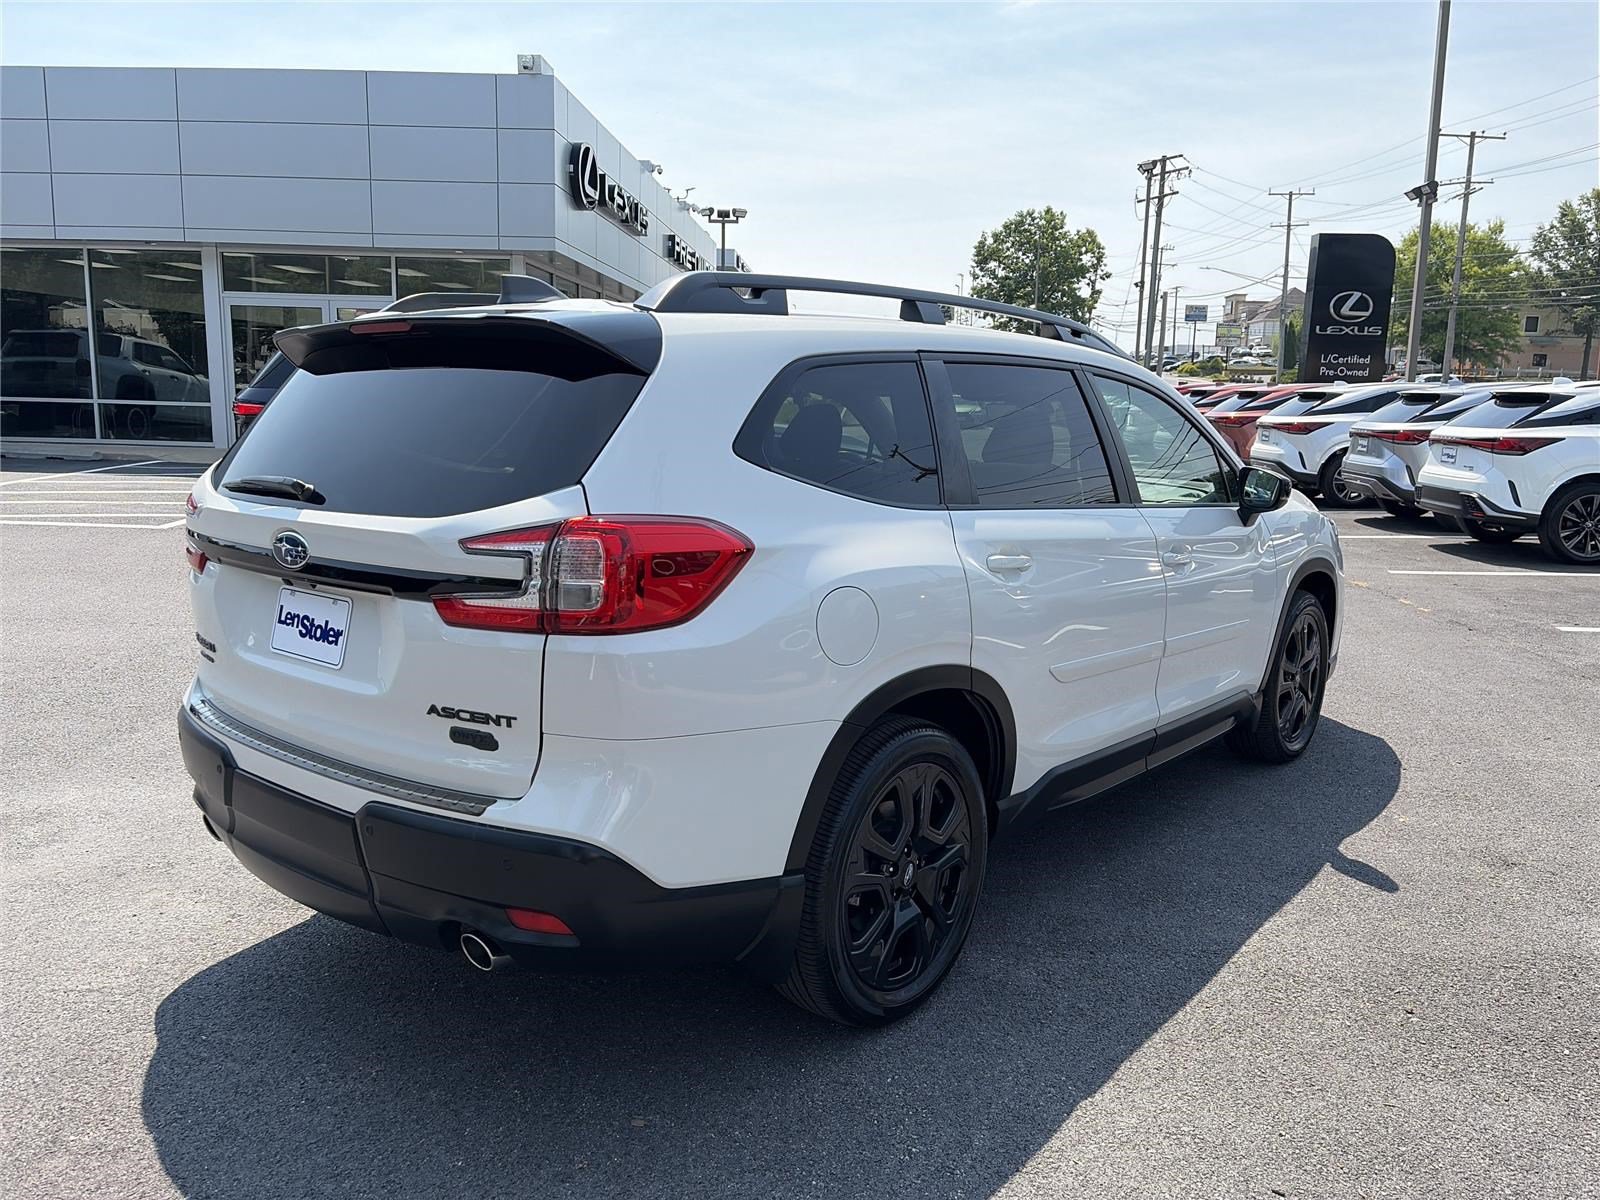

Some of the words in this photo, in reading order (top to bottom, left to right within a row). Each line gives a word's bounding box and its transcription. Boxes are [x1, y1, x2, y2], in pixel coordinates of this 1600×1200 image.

[599, 174, 649, 236] LEXUS
[1315, 325, 1383, 336] LEXUS
[1320, 353, 1371, 364] L/Certified
[1319, 366, 1370, 377] Pre-Owned
[426, 704, 518, 729] ASCENT
